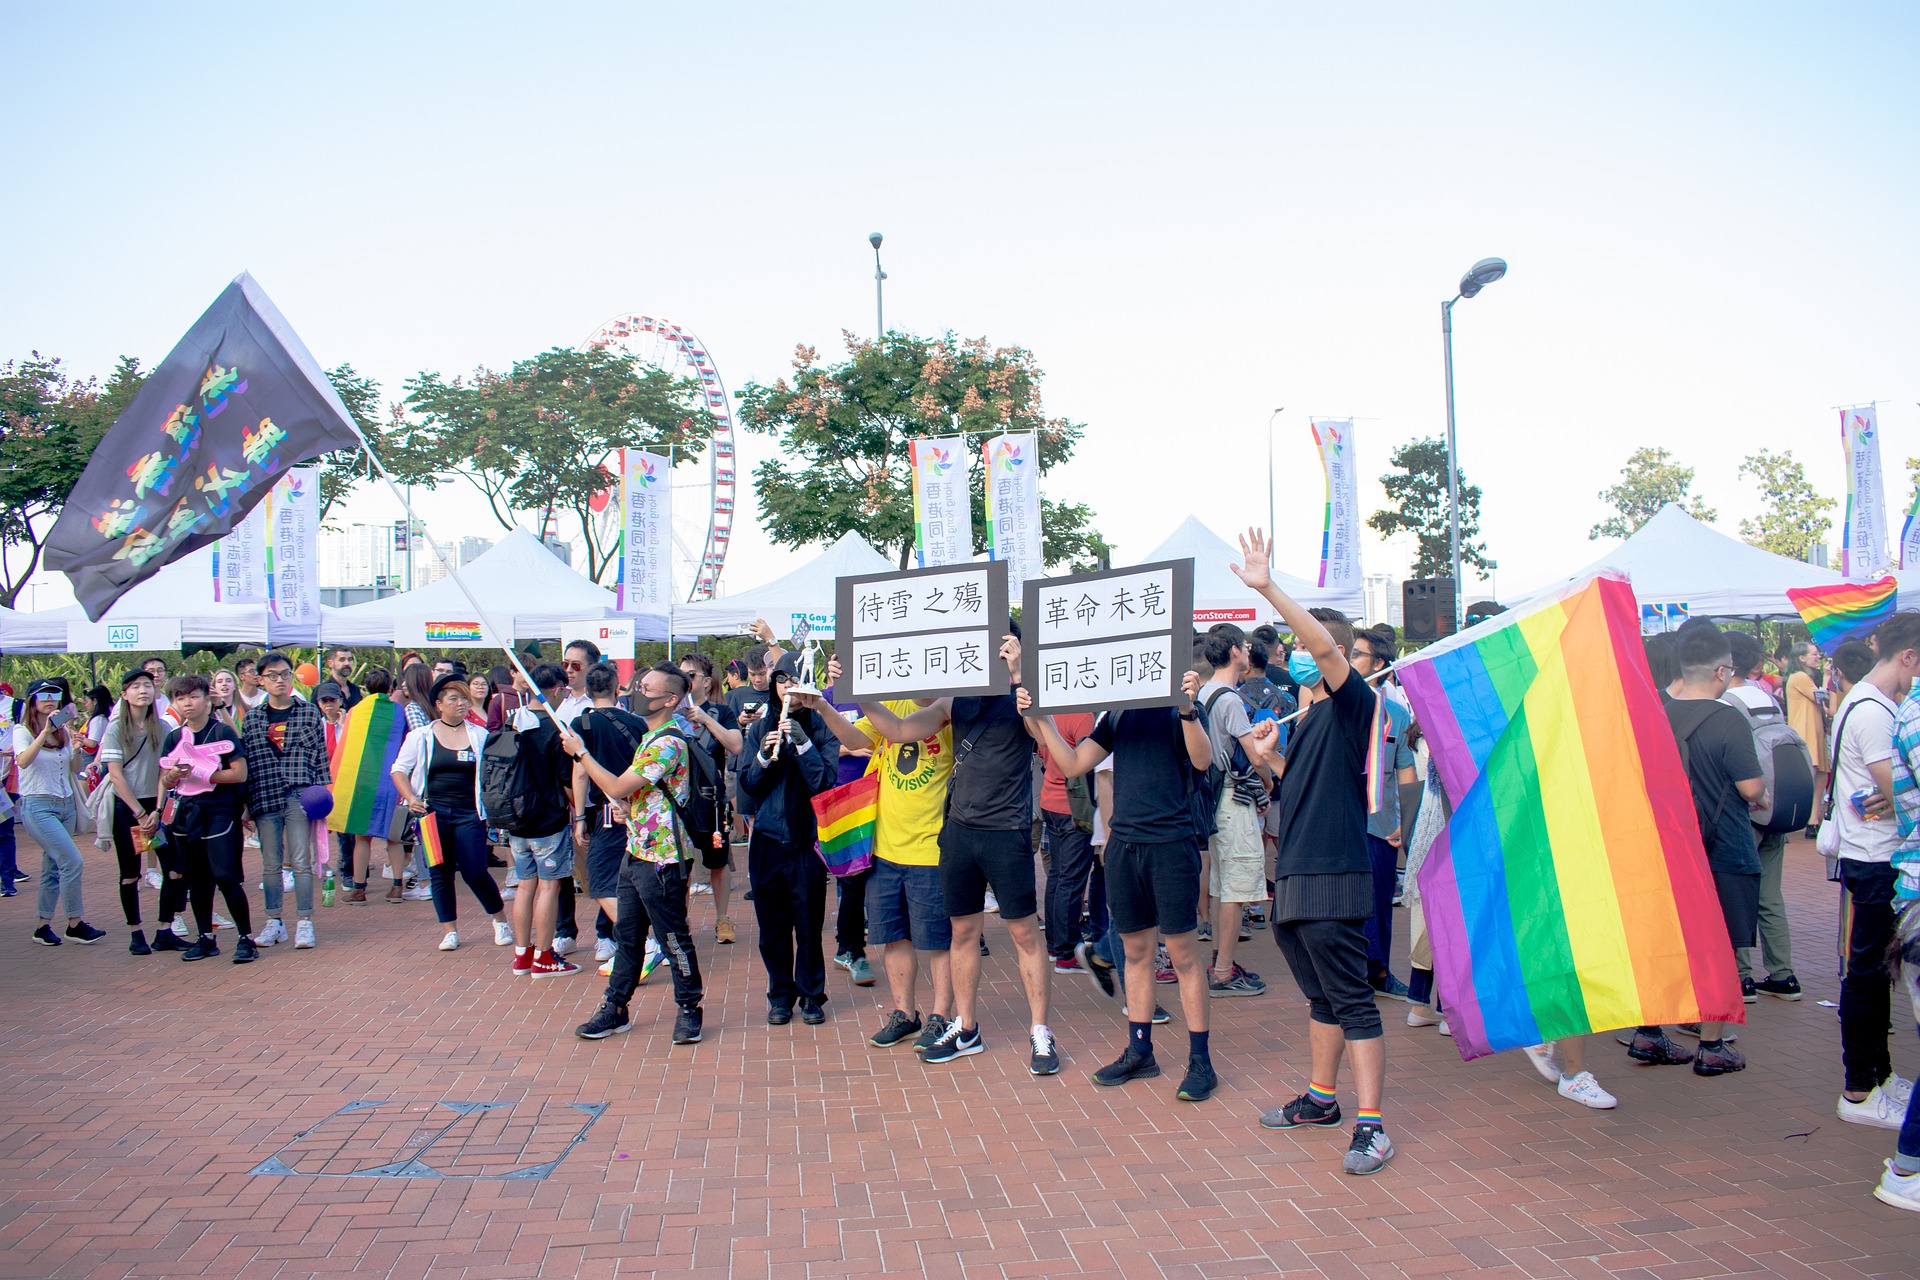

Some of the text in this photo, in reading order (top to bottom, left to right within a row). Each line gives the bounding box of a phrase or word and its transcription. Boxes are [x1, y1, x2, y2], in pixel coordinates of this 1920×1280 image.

[809, 613, 827, 623] Gay
[857, 581, 983, 623] 待雪之殤
[1044, 582, 1166, 629] 革命未竟
[112, 628, 135, 640] AIG
[446, 627, 475, 637] Fidelity
[859, 642, 983, 680] 同志同哀
[1045, 650, 1167, 691] 同志同路
